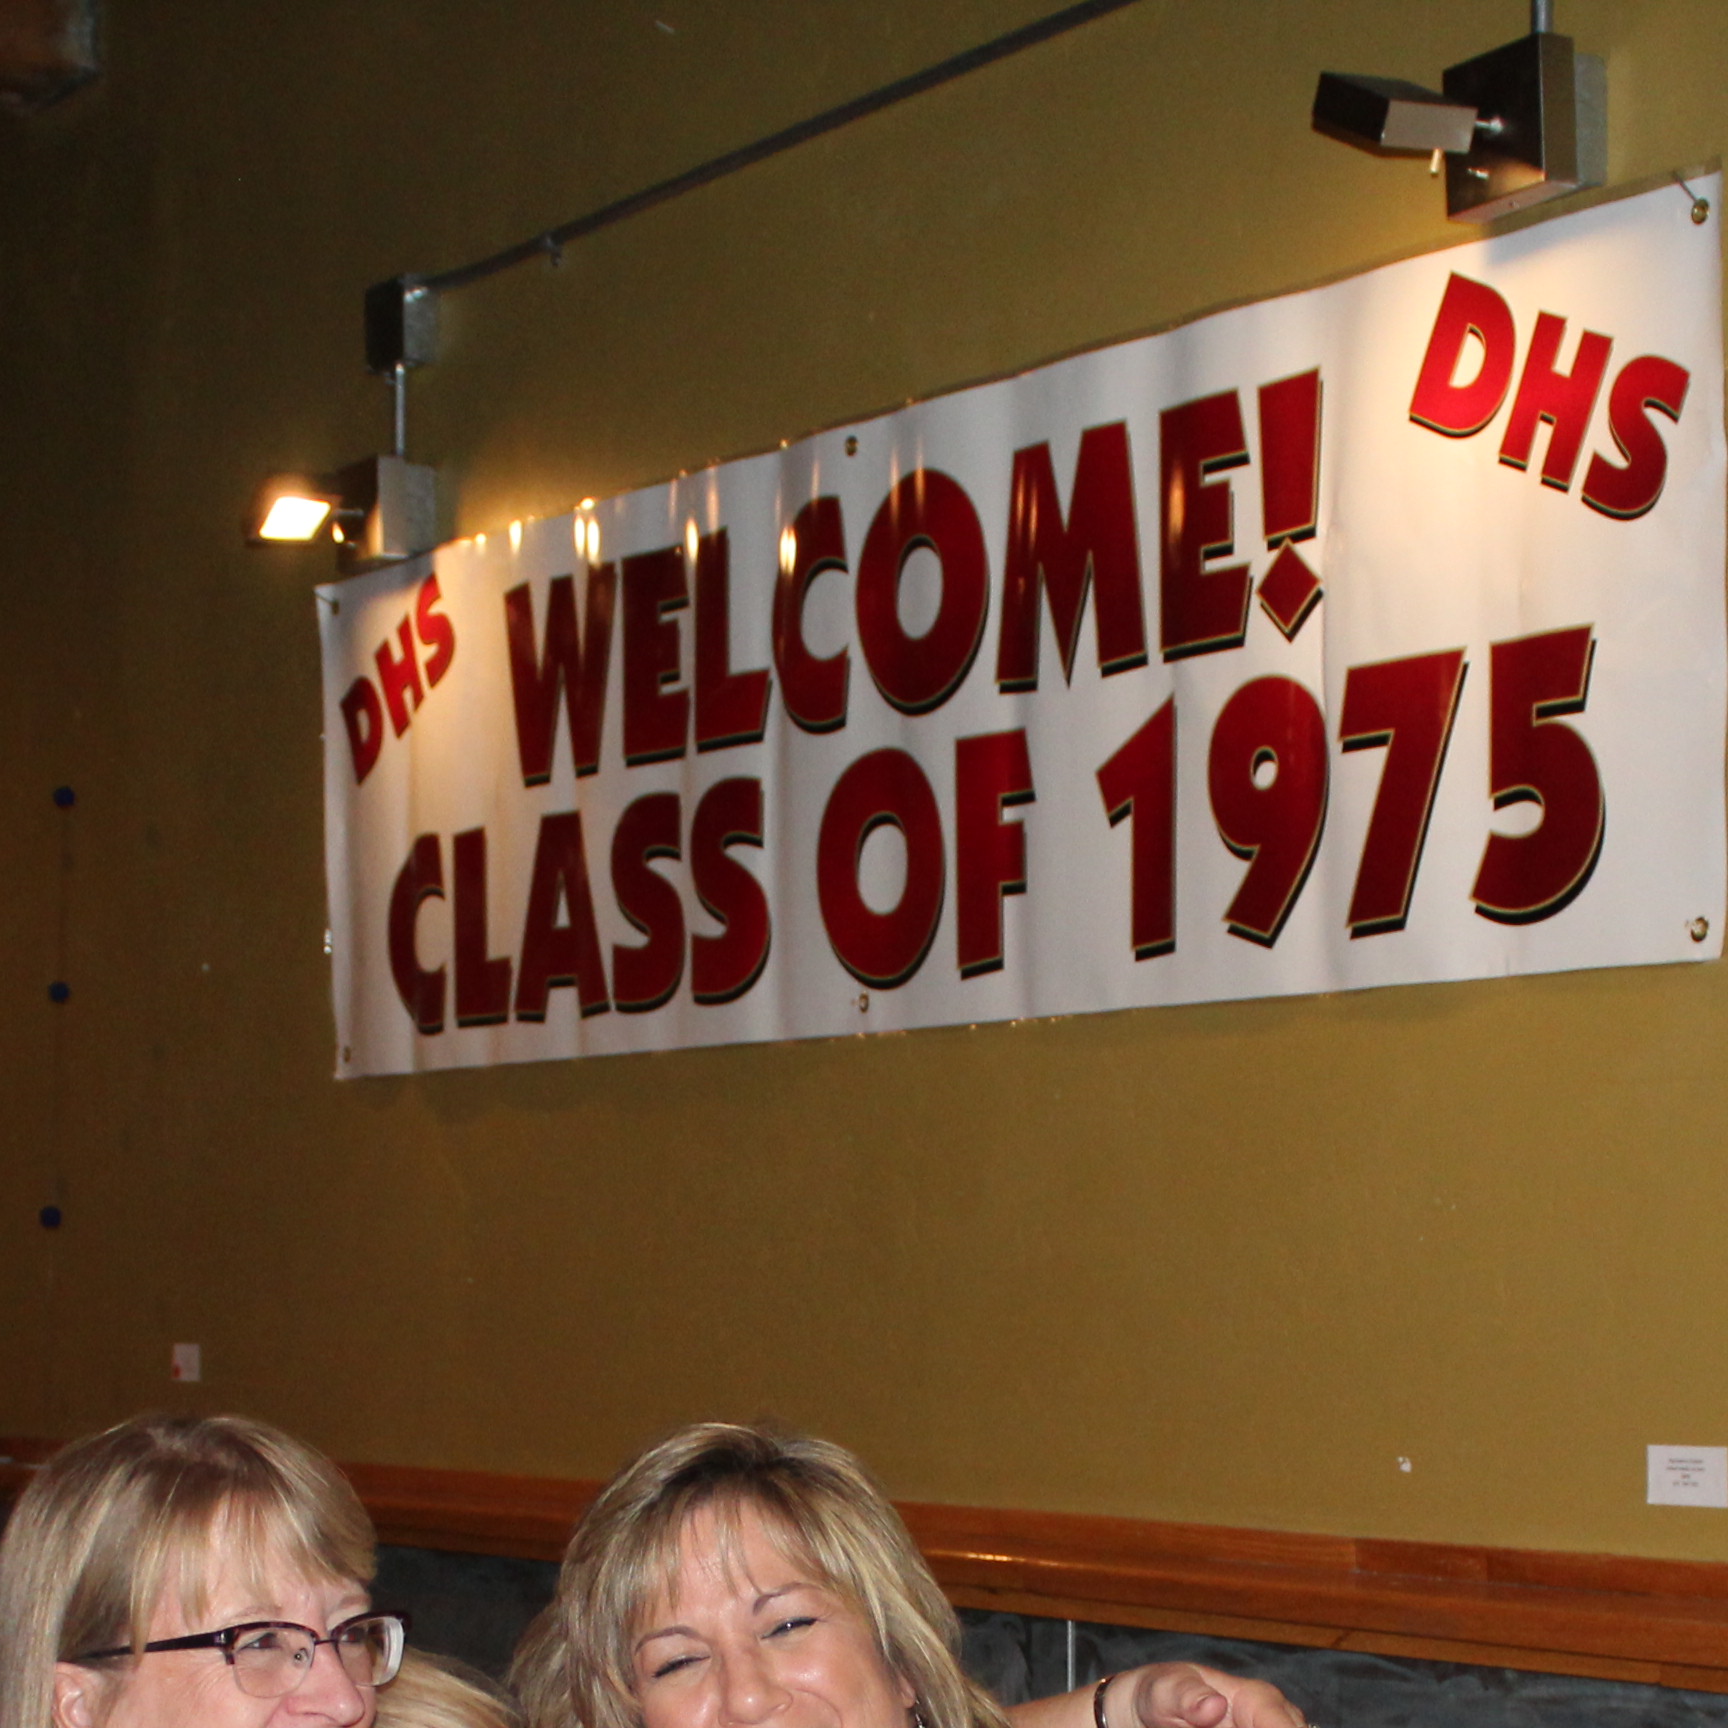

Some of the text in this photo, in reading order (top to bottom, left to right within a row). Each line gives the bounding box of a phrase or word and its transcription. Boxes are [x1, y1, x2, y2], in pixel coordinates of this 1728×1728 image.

[1408, 272, 1690, 520] DHS
[340, 572, 458, 786] DHS
[502, 368, 1323, 788] WELCOME!
[386, 624, 1606, 1034] CLASS OF 1975
